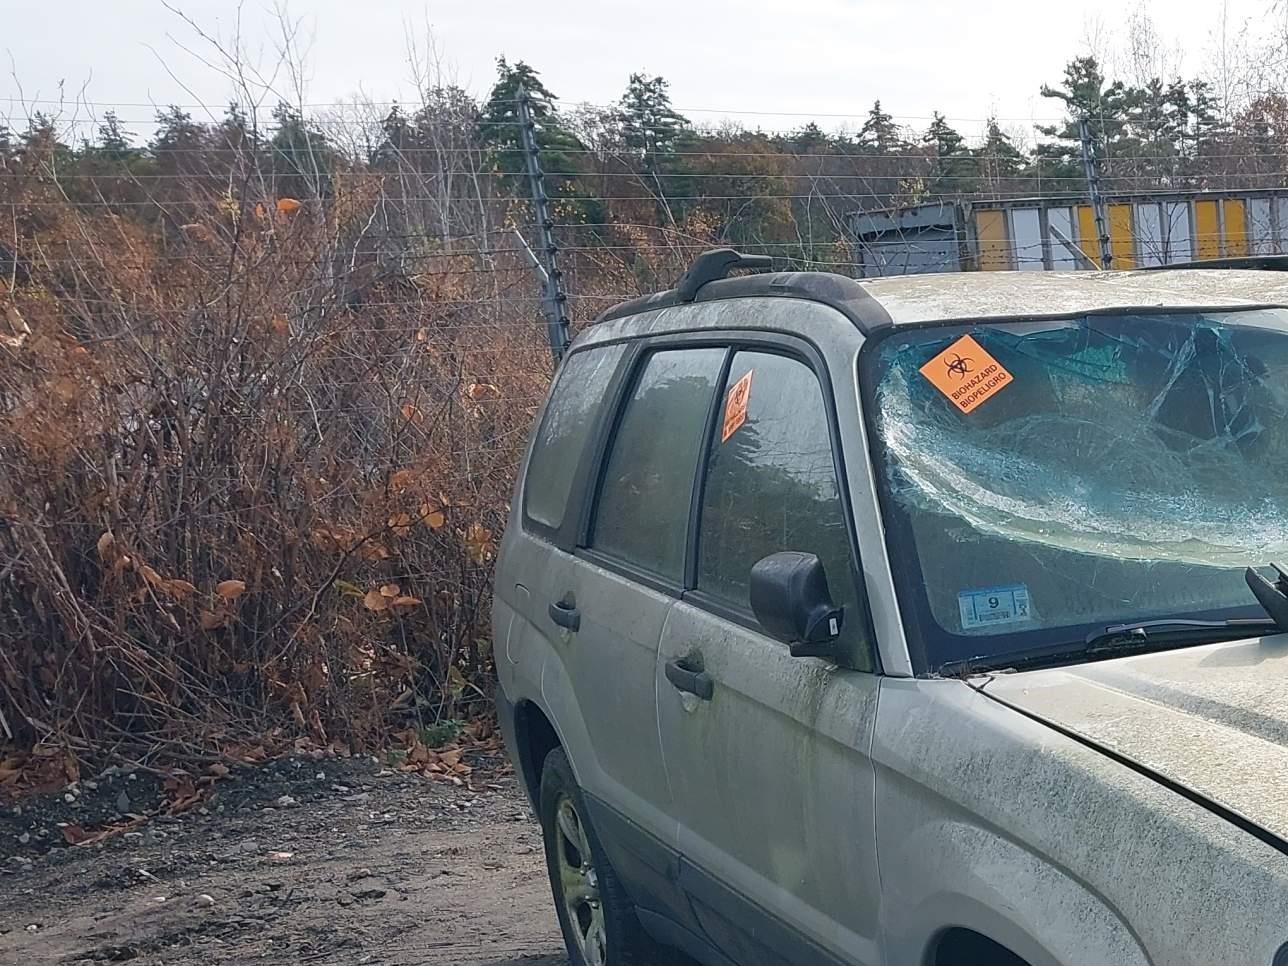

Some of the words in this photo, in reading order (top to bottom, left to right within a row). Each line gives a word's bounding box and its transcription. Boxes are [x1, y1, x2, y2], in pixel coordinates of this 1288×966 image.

[951, 363, 998, 400] BIOHAZARD
[959, 372, 1007, 409] BIOPELIGRO
[988, 597, 999, 609] 9
